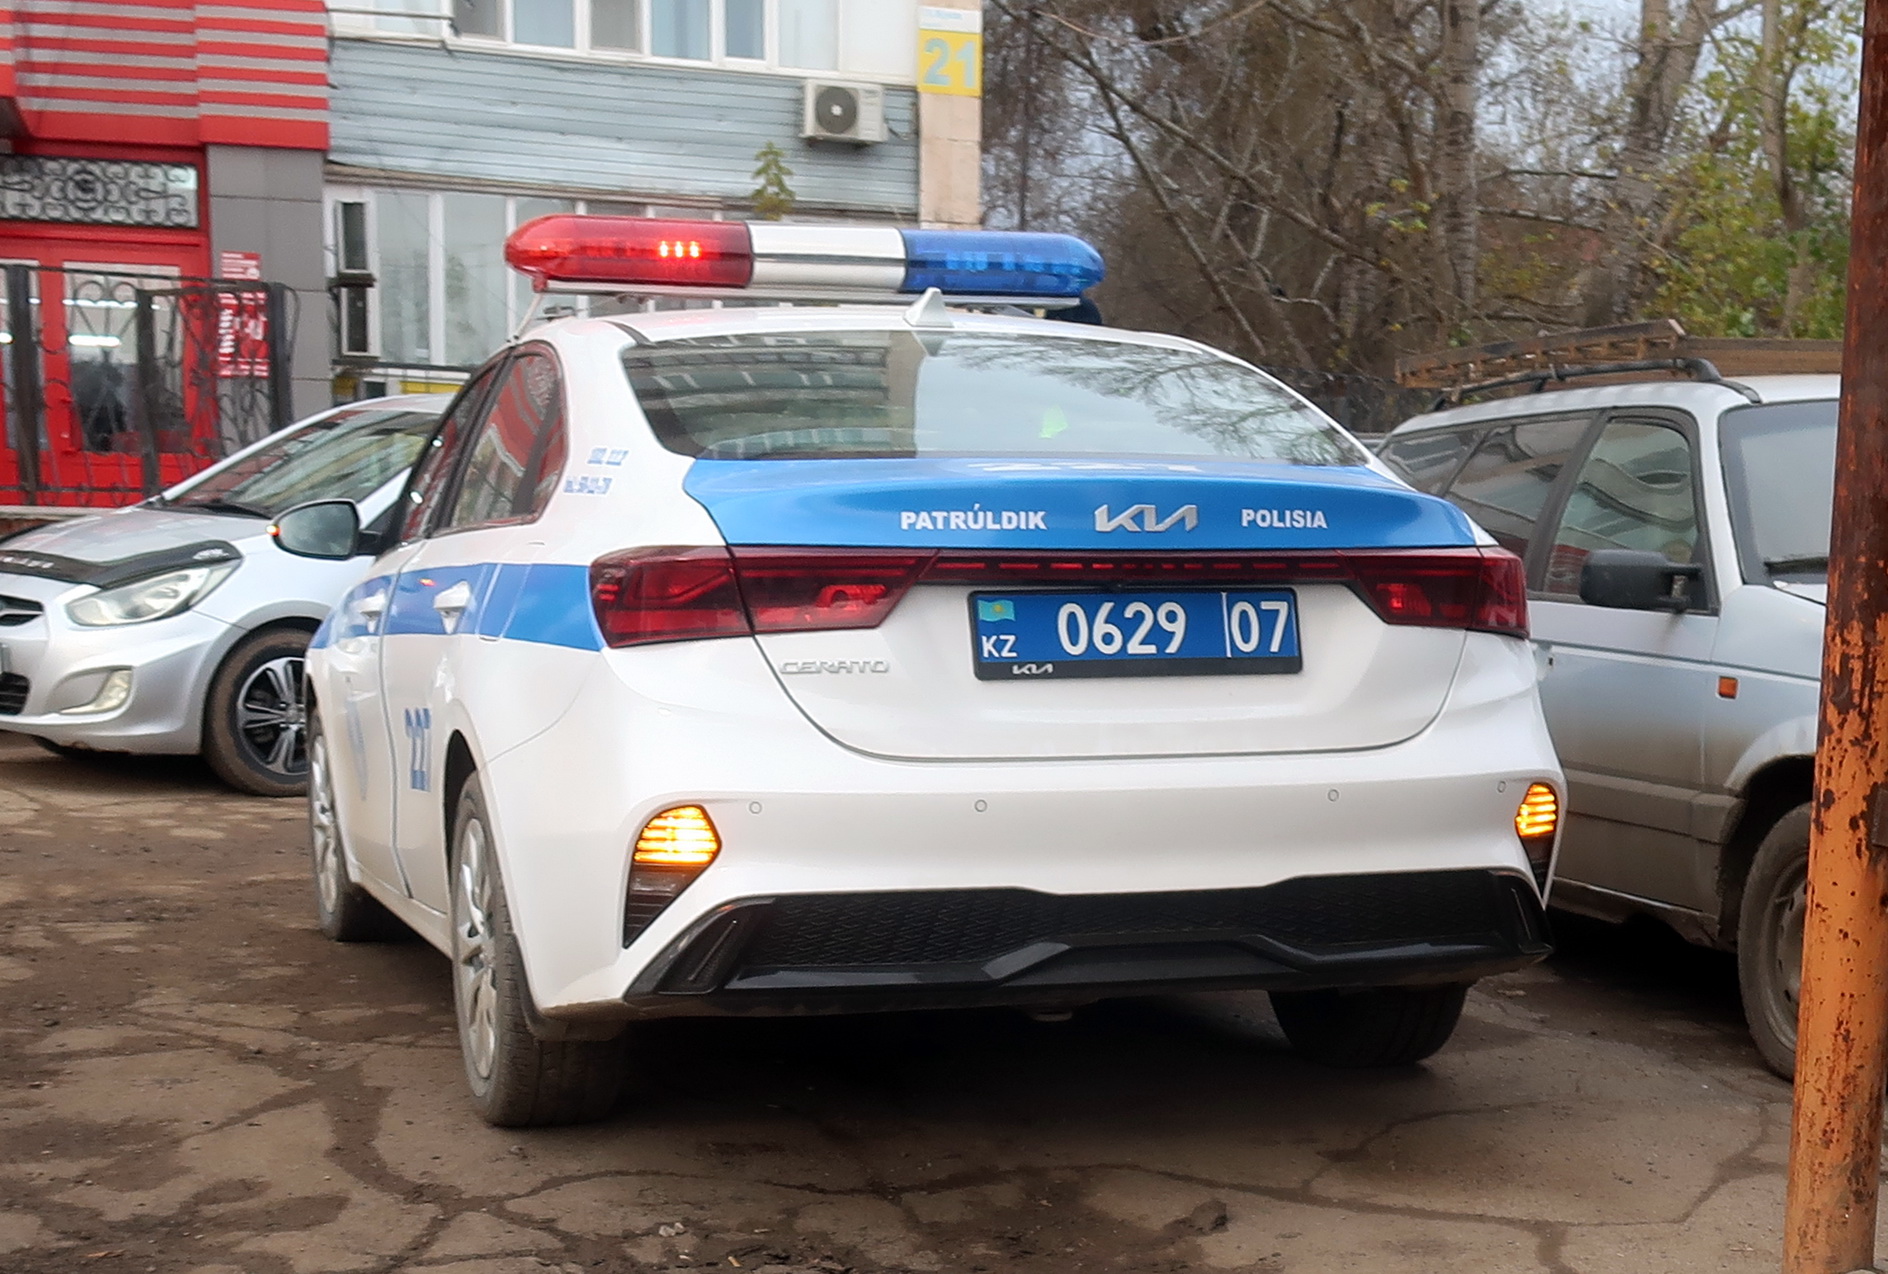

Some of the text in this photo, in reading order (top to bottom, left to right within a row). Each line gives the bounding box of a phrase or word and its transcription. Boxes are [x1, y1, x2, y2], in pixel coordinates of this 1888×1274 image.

[924, 37, 976, 88] 21
[900, 503, 1047, 530] PATRÚLDIK
[1094, 504, 1198, 532] KIA
[1241, 508, 1328, 529] POLISIA
[1057, 601, 1289, 656] 0629 07
[981, 634, 1018, 658] KZ
[780, 660, 890, 674] CERATO
